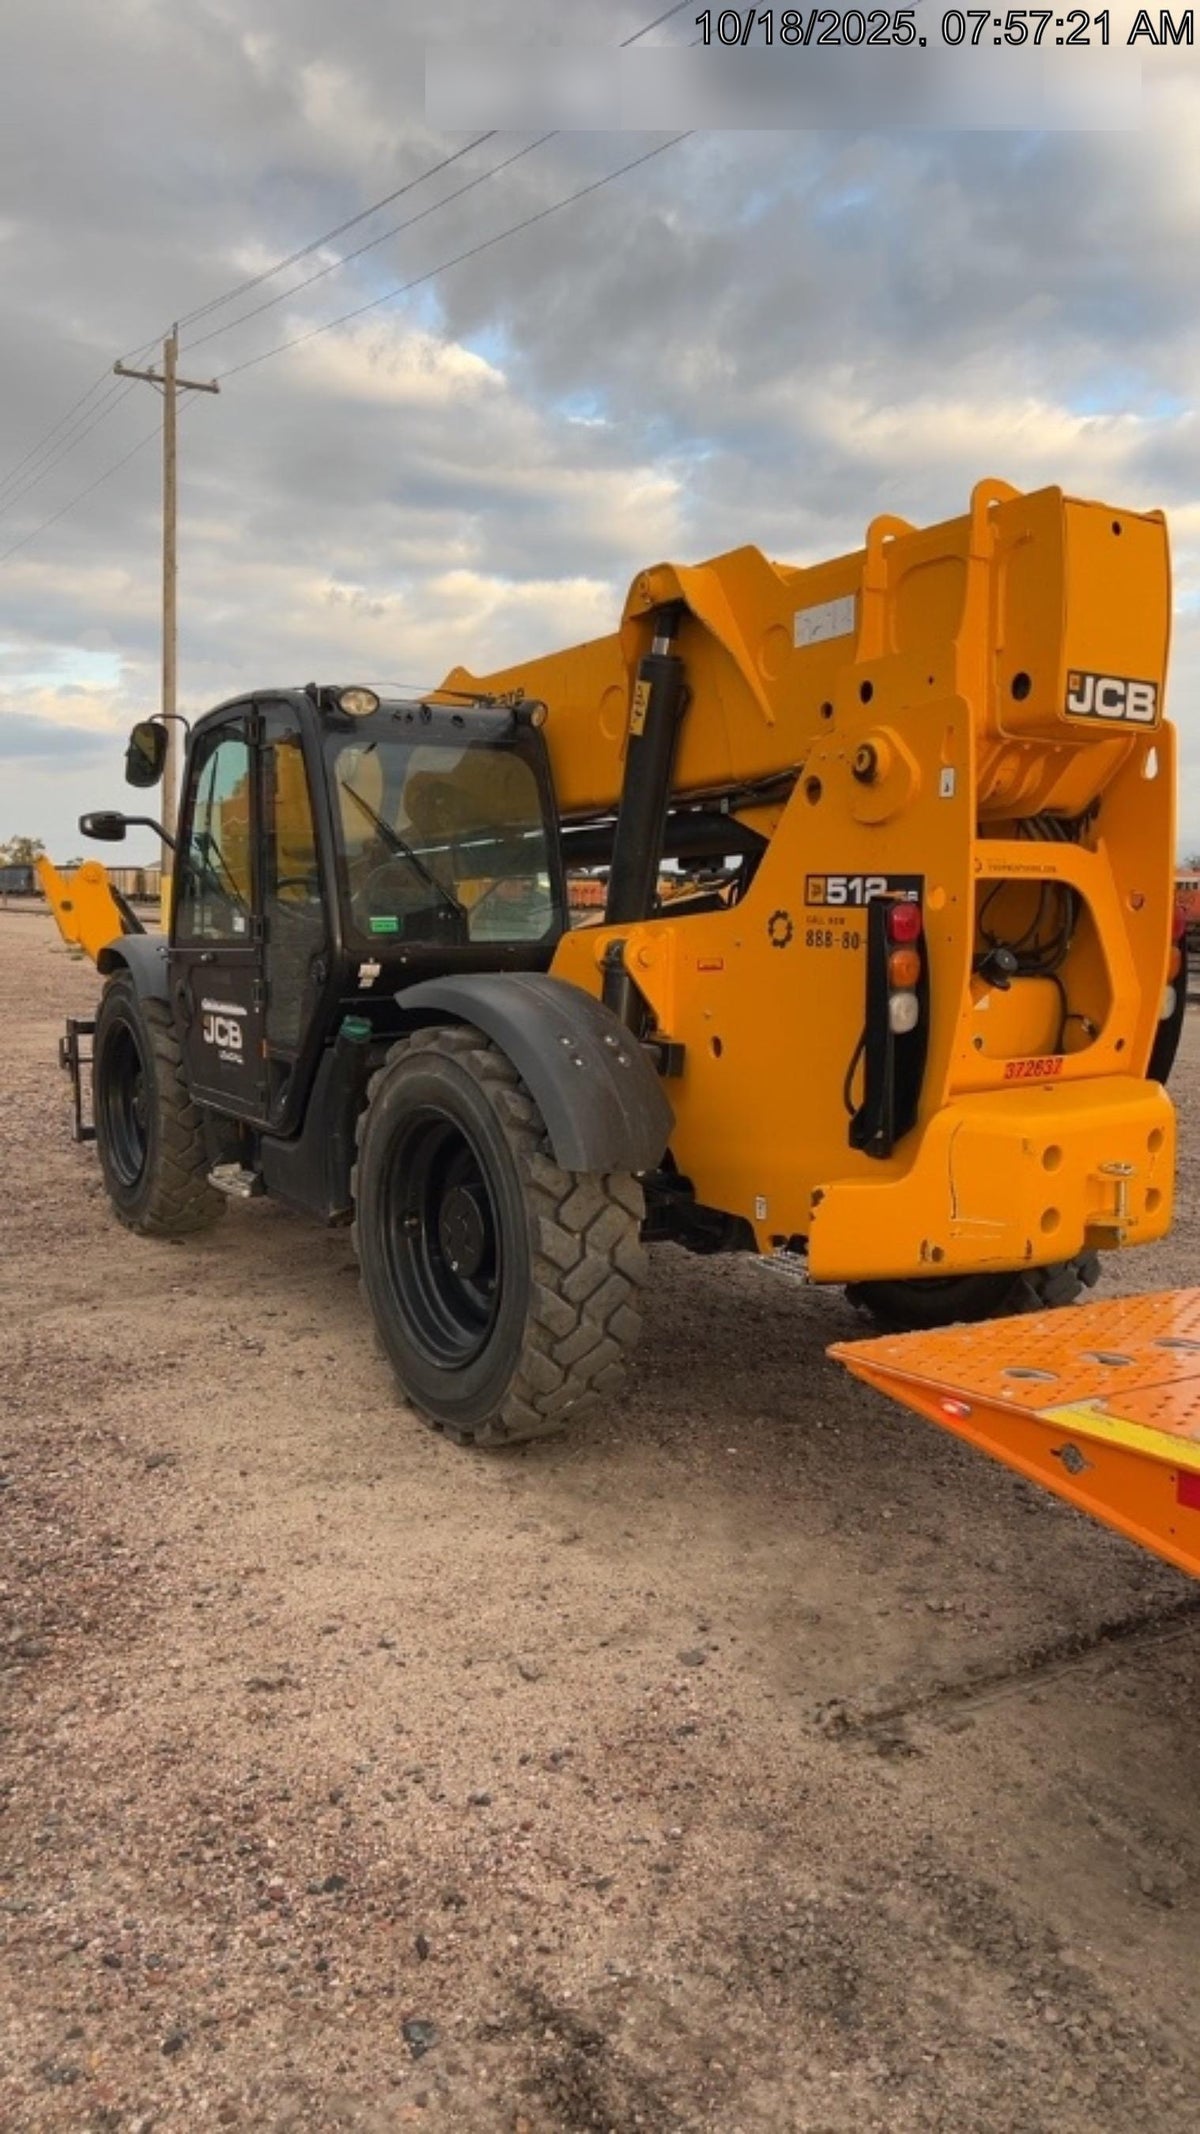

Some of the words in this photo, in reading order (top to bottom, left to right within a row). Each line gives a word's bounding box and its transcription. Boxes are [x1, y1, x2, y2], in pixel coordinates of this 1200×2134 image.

[1068, 675, 1155, 721] JCB
[203, 1013, 243, 1049] JCB
[1004, 1057, 1063, 1080] 372637
